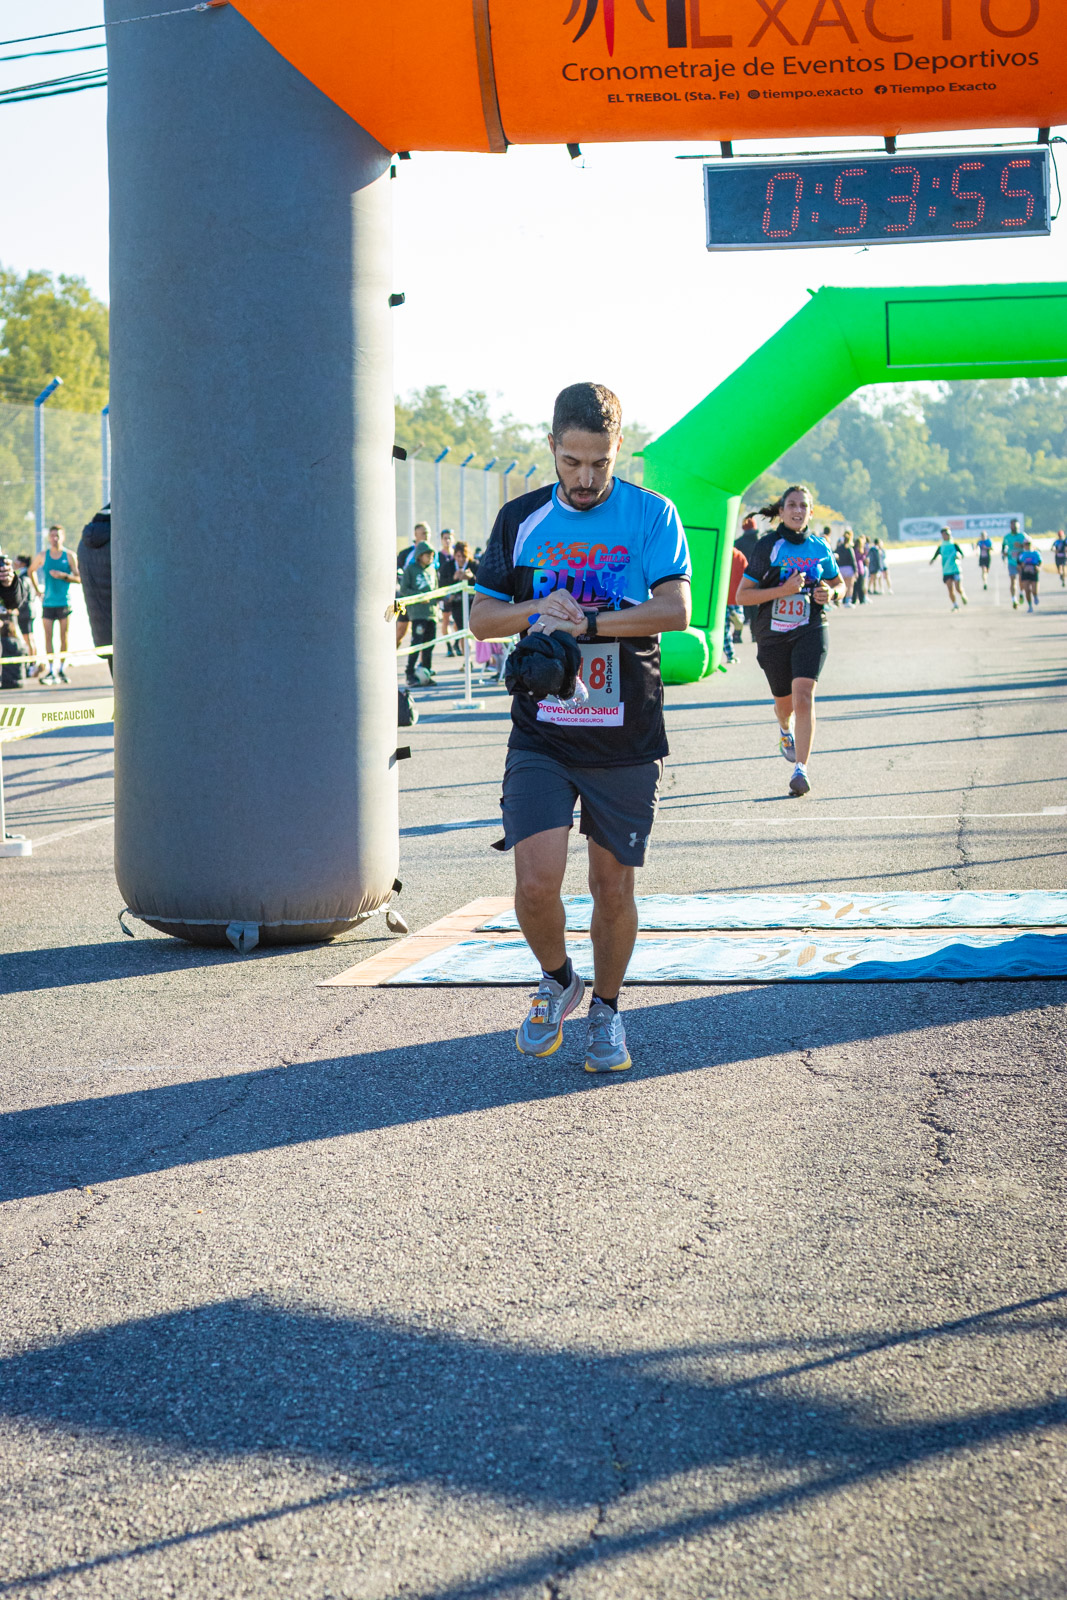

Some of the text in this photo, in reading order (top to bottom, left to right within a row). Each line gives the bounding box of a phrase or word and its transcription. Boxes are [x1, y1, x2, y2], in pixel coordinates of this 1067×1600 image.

[562, 49, 1039, 82] Cronometraje de Eventos Deportivos
[763, 86, 863, 99] tiempo.exacto
[890, 81, 997, 95] Tiempo Exacto
[608, 90, 740, 103] EL TREBOL (Sta. Fe)
[600, 554, 631, 564] MILLAS
[778, 599, 803, 616] 213
[41, 708, 95, 722] PRECAUCION
[591, 706, 619, 715] Salud
